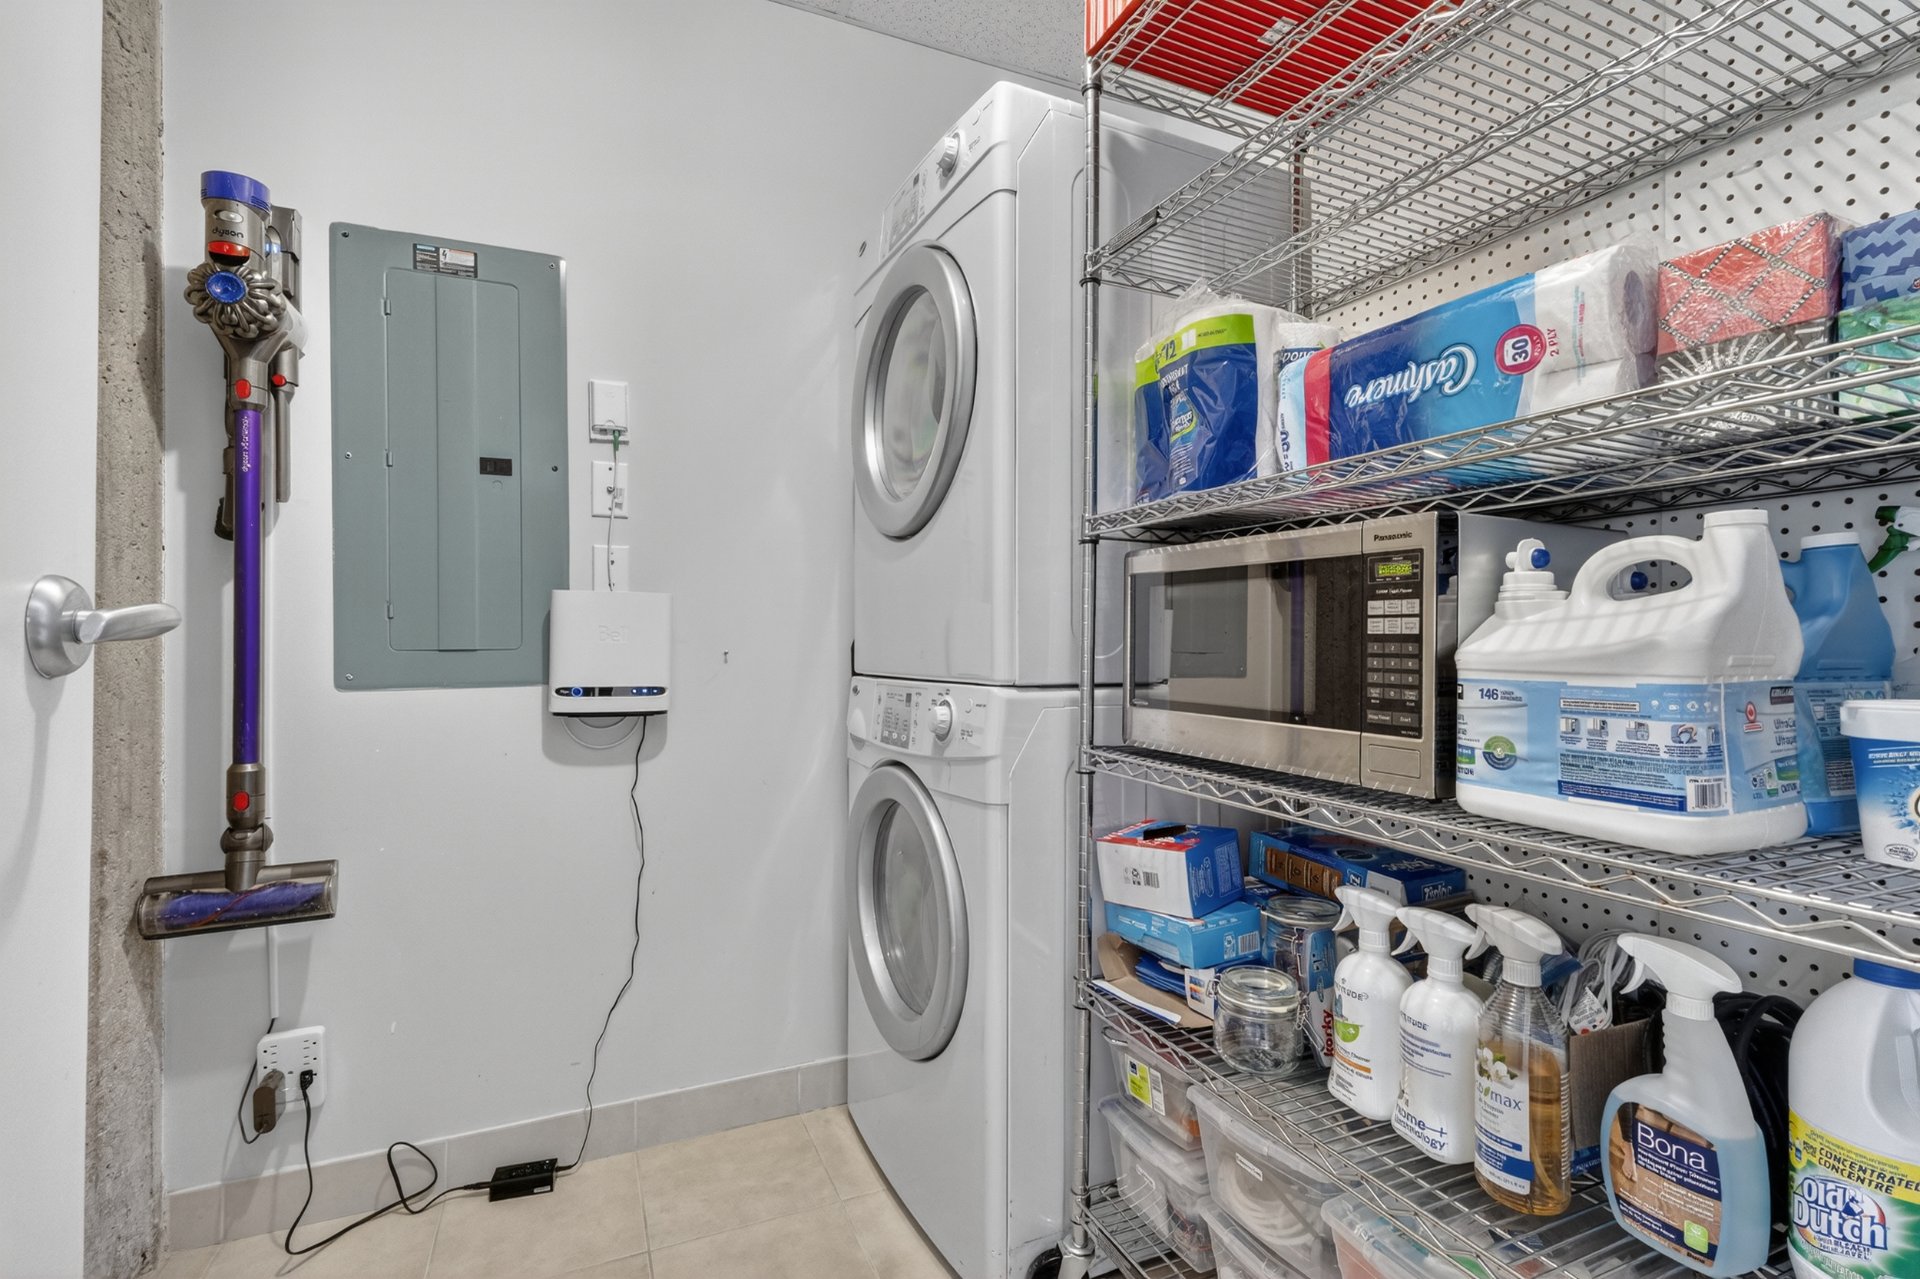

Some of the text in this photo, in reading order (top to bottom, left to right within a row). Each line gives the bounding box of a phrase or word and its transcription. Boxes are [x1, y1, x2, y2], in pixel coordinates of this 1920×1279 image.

[212, 227, 244, 238] dyson
[1547, 328, 1558, 346] PLY
[1511, 338, 1529, 362] 30
[1344, 343, 1477, 409] Cashmere
[1374, 531, 1413, 541] Panasonic
[1479, 688, 1499, 700] 146
[1637, 1122, 1708, 1173] Bona
[1803, 1178, 1845, 1212] Old
[1793, 1193, 1887, 1250] Dutch
